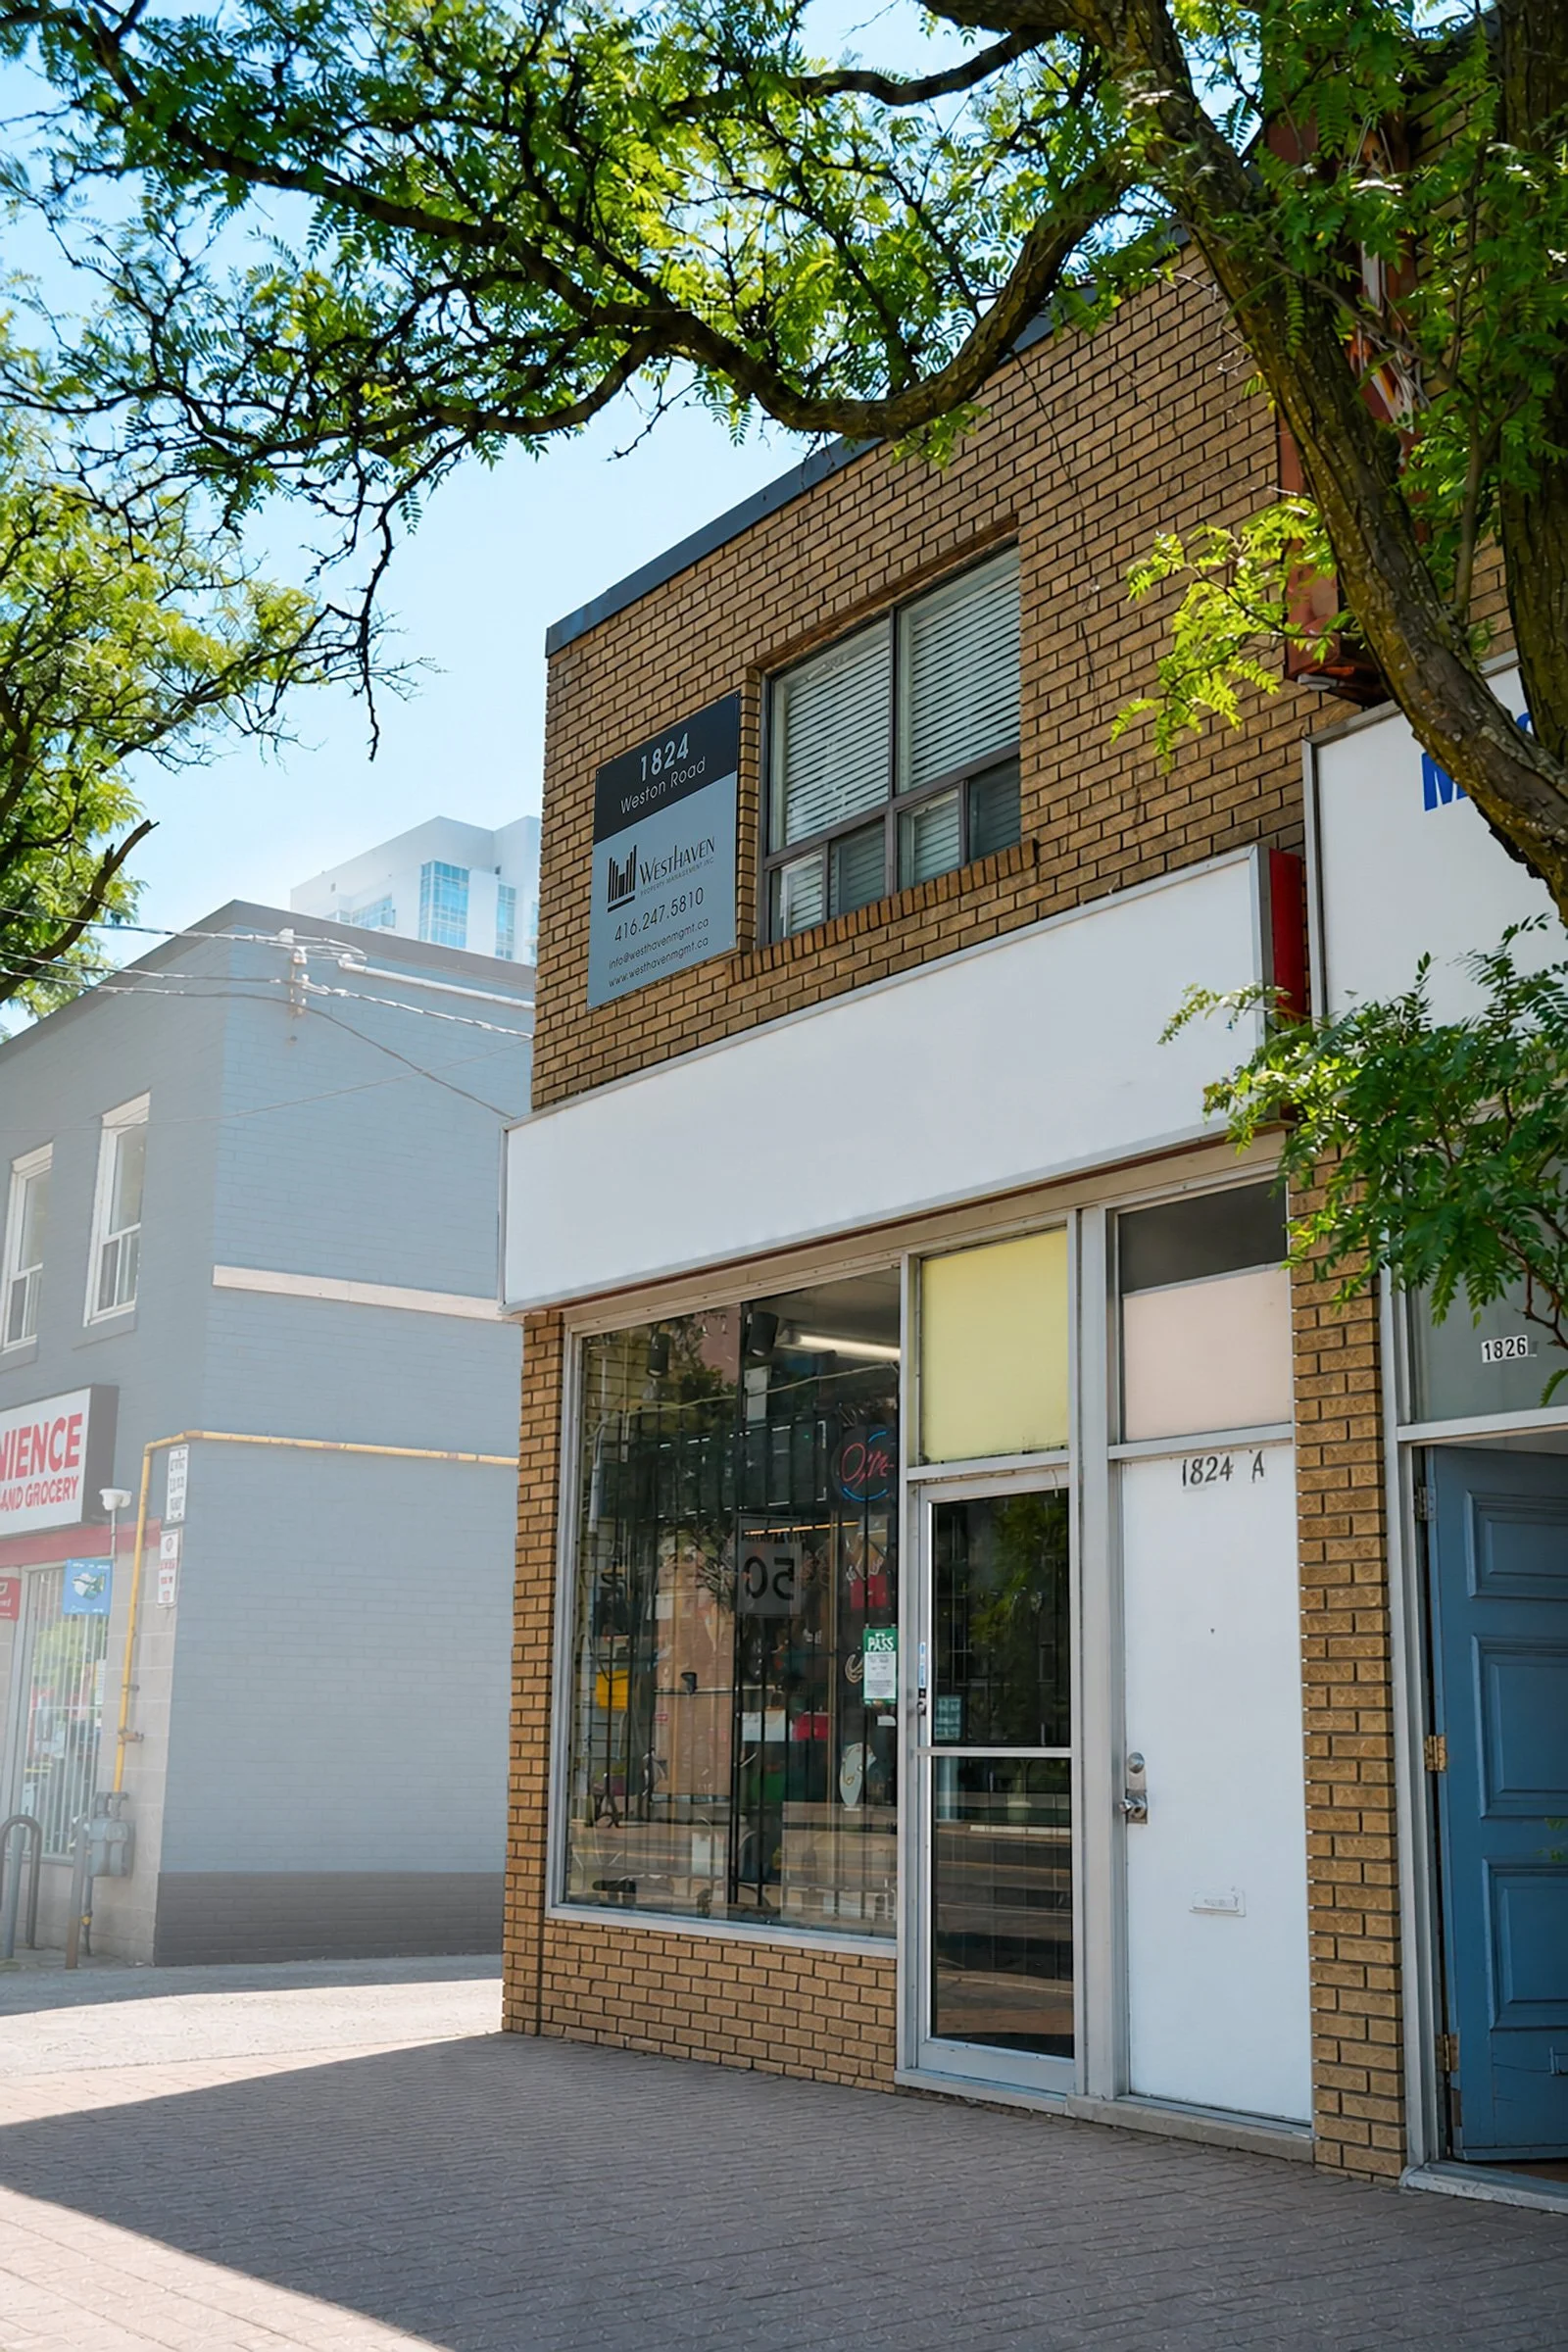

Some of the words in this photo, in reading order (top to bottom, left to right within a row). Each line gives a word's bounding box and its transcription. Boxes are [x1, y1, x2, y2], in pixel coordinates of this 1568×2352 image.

[641, 732, 689, 782] 1824
[620, 780, 666, 814] Weston
[670, 756, 706, 788] Road
[640, 881, 664, 897] PROPERTY
[614, 887, 704, 942] 416.247.5810
[609, 918, 709, 970] info@westhavenmgmt.ca
[609, 937, 709, 988] www.westhavenmgmt.ca
[1485, 1337, 1526, 1360] 1826
[1181, 1455, 1234, 1487] 1824
[1251, 1449, 1264, 1484] A
[0, 1486, 24, 1511] AND
[25, 1475, 78, 1507] GROCERY
[867, 1636, 895, 1652] PASS
